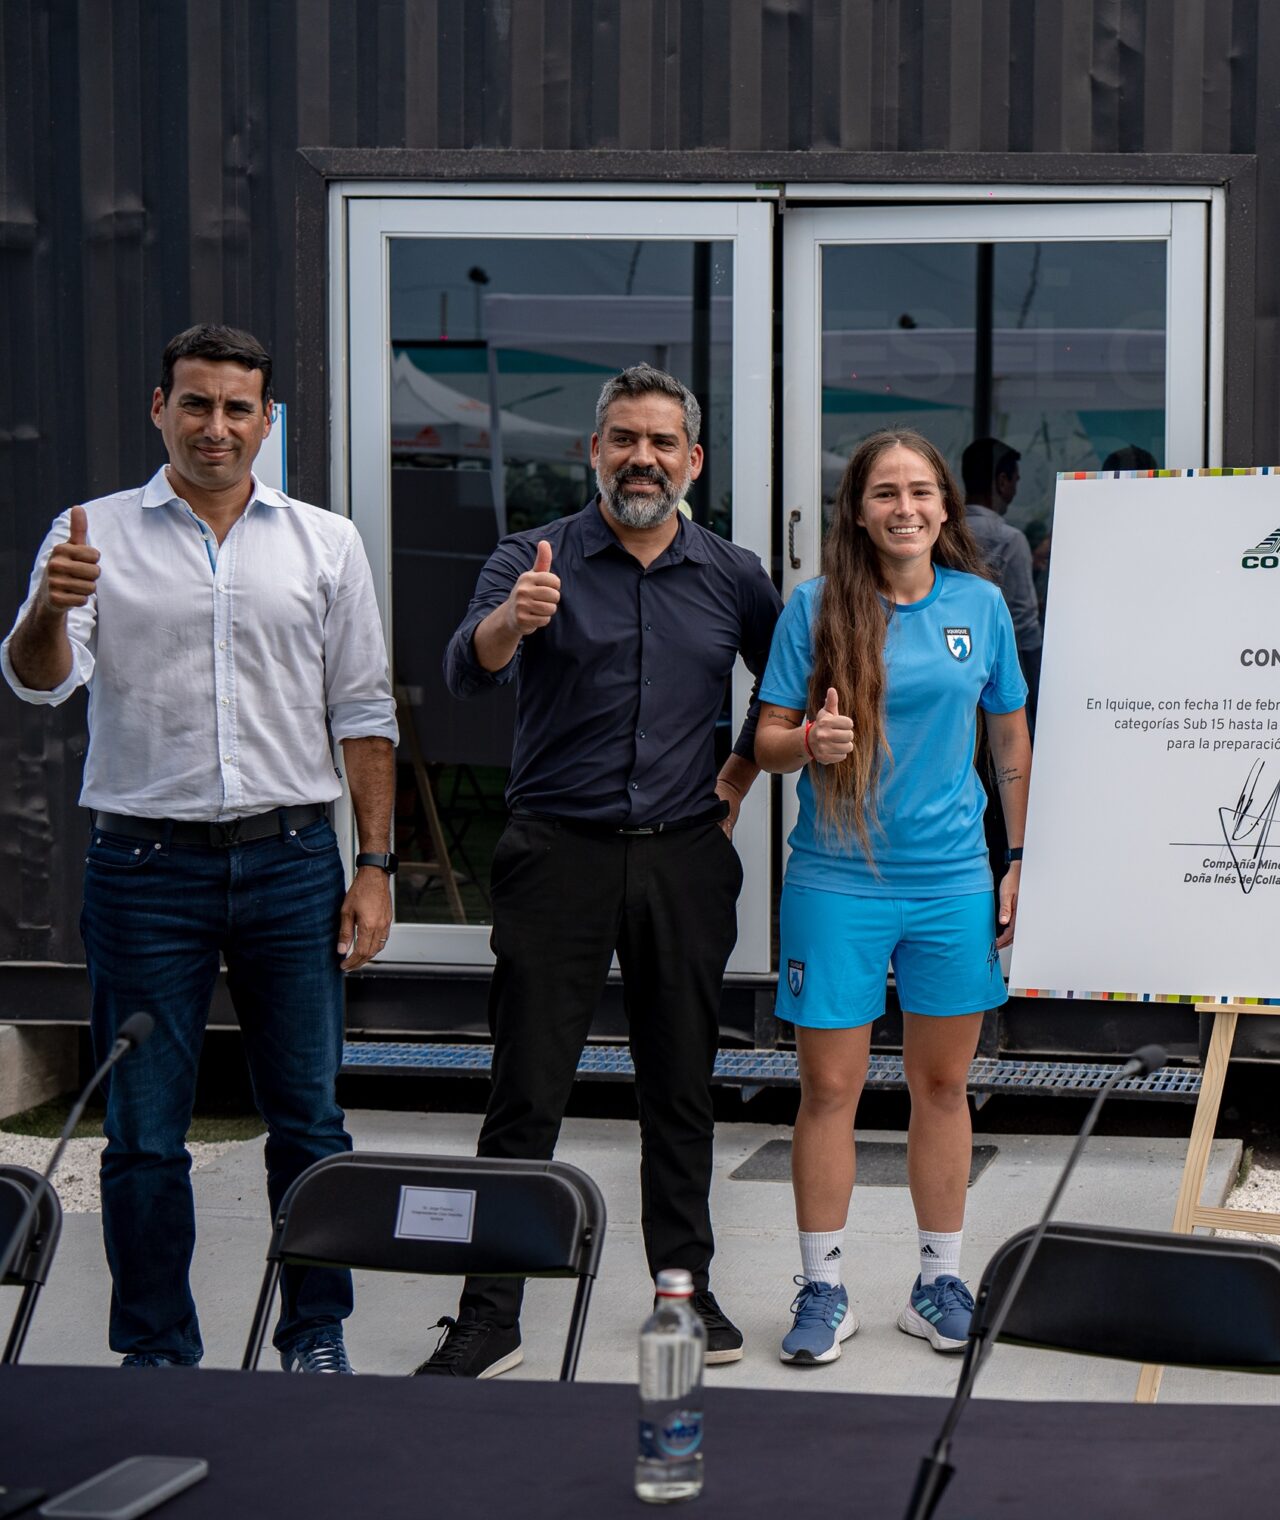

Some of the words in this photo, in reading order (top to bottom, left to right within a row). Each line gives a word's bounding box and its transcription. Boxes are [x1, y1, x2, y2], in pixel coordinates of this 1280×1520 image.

[1086, 697, 1102, 710] En
[1105, 698, 1155, 713] Iquique,
[1157, 700, 1181, 711] con
[1183, 698, 1219, 711] fecha
[1222, 698, 1233, 711] 11
[1236, 698, 1252, 711] de
[1114, 717, 1180, 732] categorías
[1183, 717, 1208, 730] Sub
[1211, 717, 1225, 730] 15
[1228, 717, 1264, 731] hasta
[1266, 718, 1278, 731] la
[1166, 739, 1196, 752] para
[1198, 737, 1210, 750] la
[1202, 858, 1256, 871] Compañía
[1183, 873, 1212, 883] Doña
[1214, 873, 1236, 884] Inés
[1240, 874, 1253, 884] de
